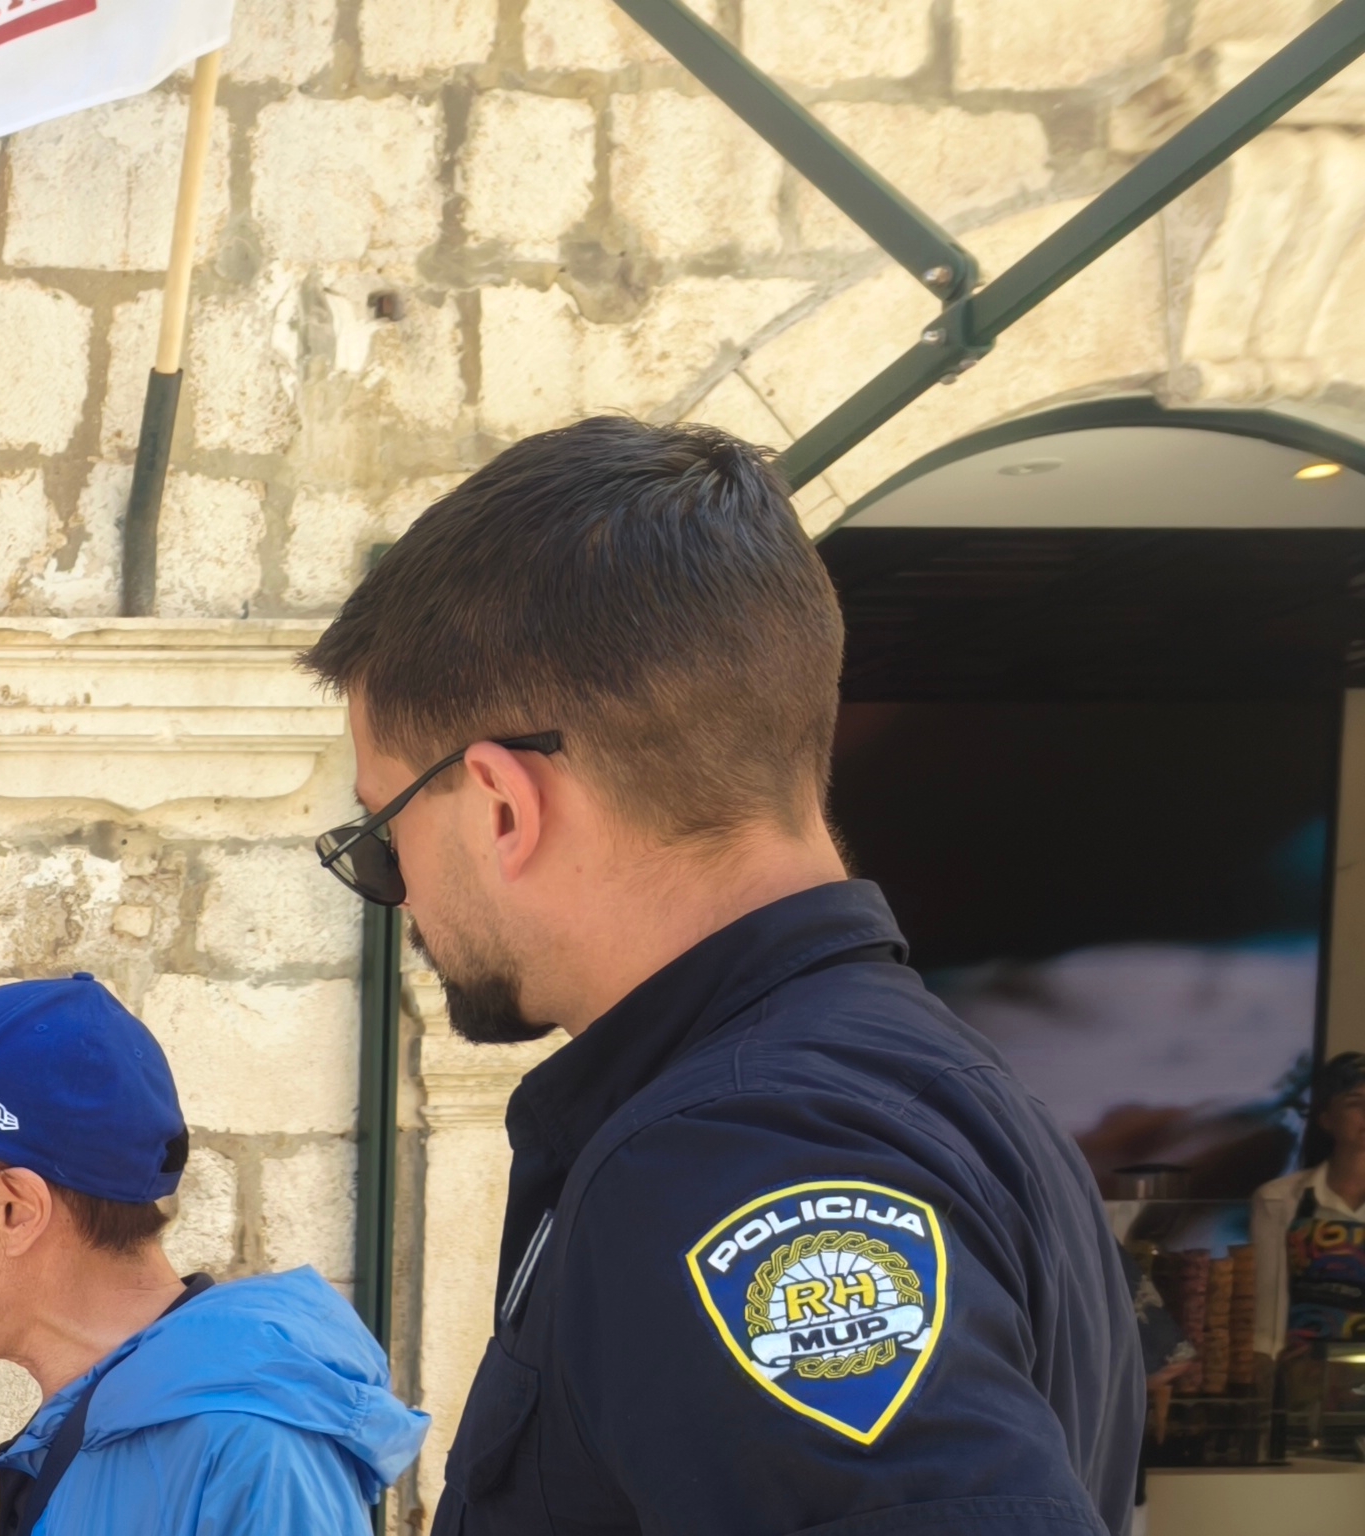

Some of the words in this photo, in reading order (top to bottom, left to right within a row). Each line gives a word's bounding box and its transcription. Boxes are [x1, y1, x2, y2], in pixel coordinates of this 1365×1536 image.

[707, 1196, 925, 1273] POLICIJA
[786, 1273, 875, 1321] RH
[789, 1315, 888, 1353] MUP
